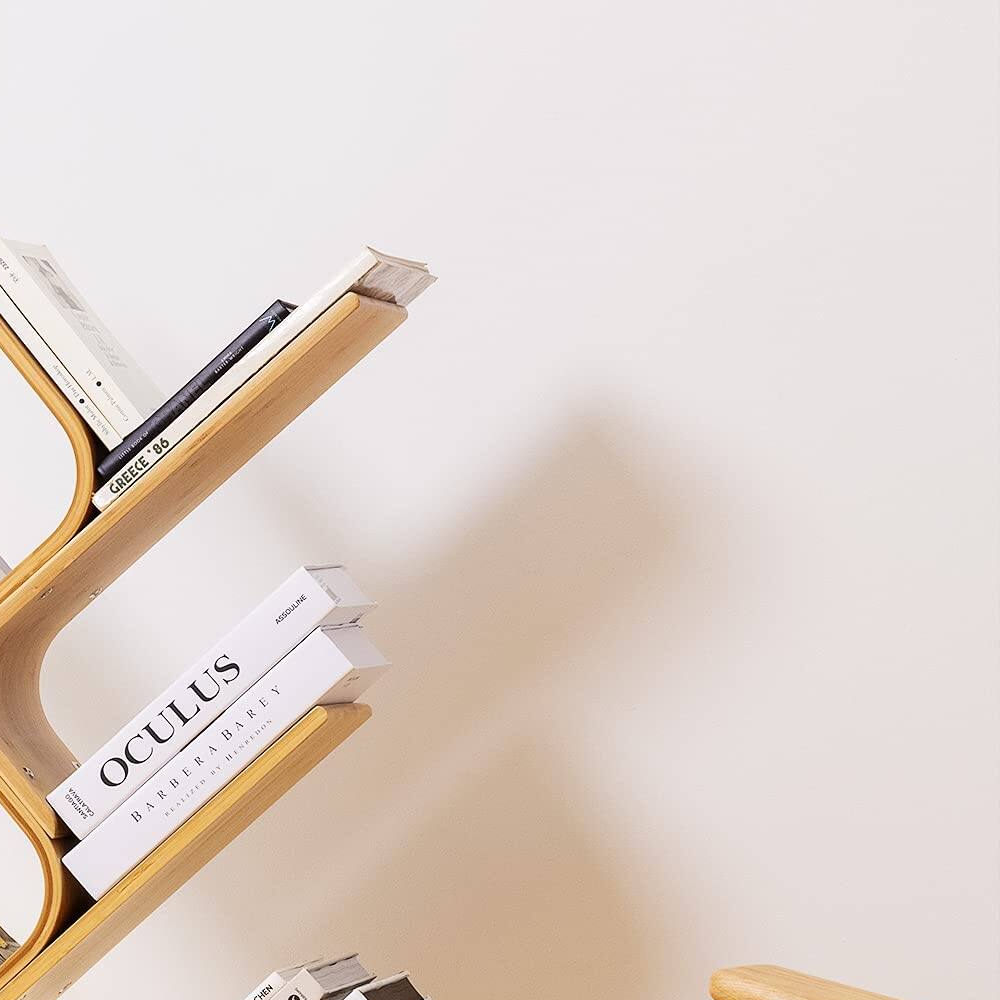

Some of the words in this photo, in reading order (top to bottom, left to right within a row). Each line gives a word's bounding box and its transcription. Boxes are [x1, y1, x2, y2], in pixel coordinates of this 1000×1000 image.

[131, 437, 143, 449] BOOK
[109, 455, 150, 494] GREECE
[275, 593, 308, 625] ASSOULINE
[100, 653, 241, 788] OCULUS
[64, 793, 89, 820] SANTIAGO
[68, 788, 95, 817] CALATRAVA
[164, 779, 206, 817] REALIZED
[210, 765, 223, 777] BY
